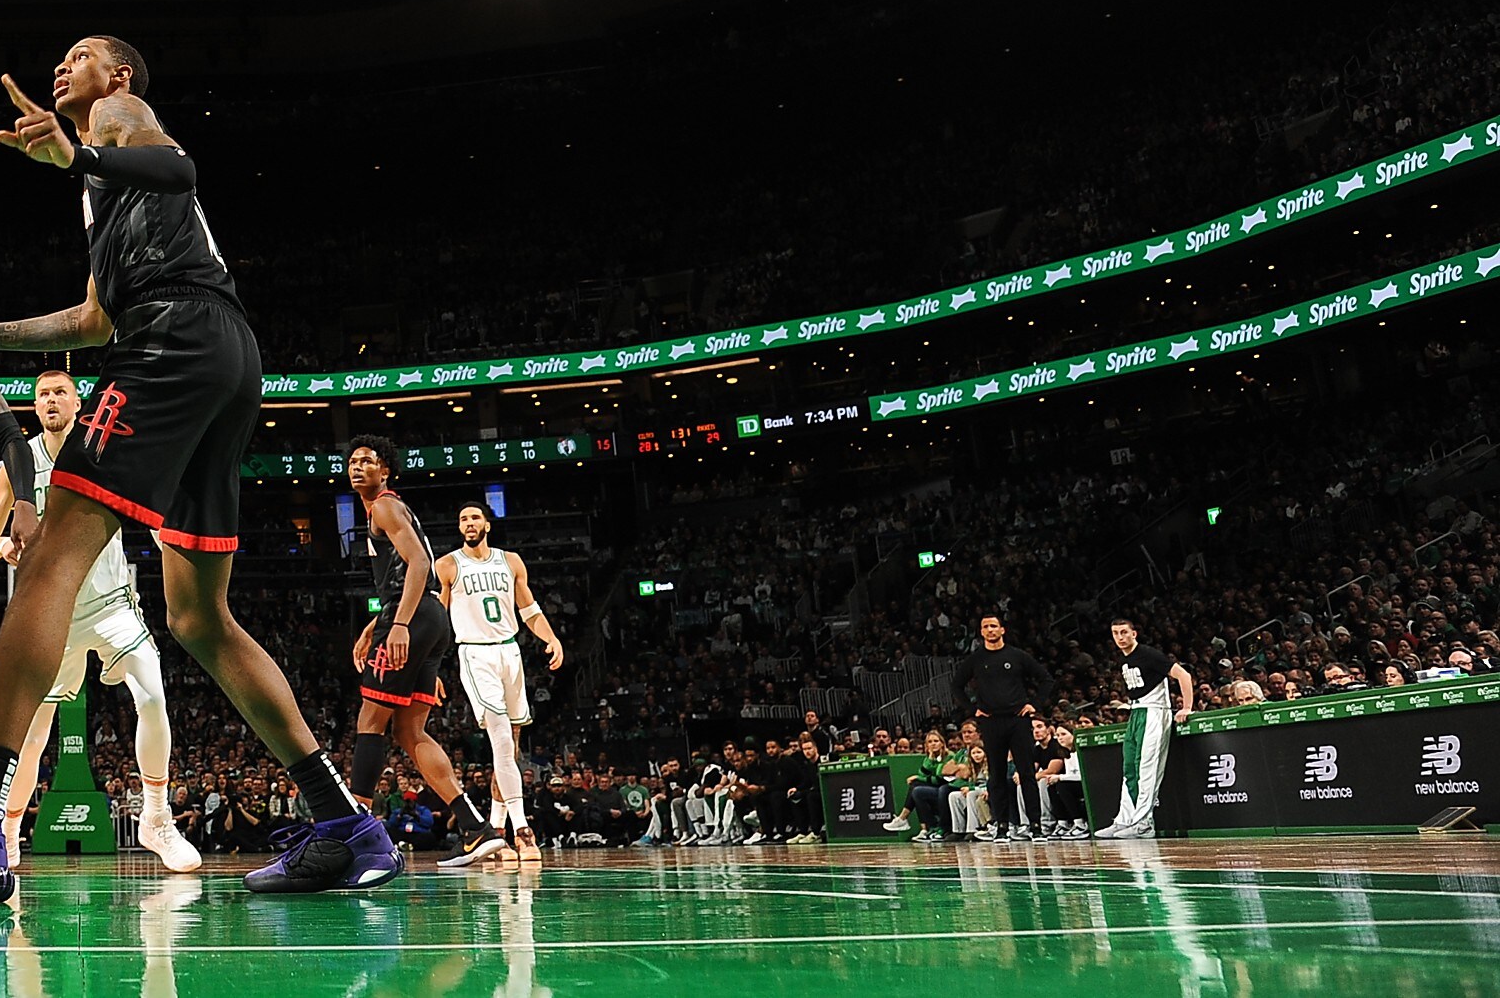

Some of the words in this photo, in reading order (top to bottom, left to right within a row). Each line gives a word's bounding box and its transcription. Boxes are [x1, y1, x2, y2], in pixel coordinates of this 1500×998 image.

[705, 333, 750, 354] Sprite
[798, 317, 846, 339] Sprite
[896, 299, 939, 323] Sprite
[986, 275, 1032, 301] Sprite
[1082, 251, 1132, 277] Sprite
[1186, 222, 1230, 252] Sprite
[1277, 189, 1324, 220] Sprite
[1376, 152, 1428, 185] Sprite
[917, 388, 963, 412] Sprite
[1009, 367, 1056, 393] Sprite
[1106, 347, 1157, 373] Sprite
[1211, 324, 1262, 351] Sprite
[1310, 295, 1358, 325] Sprite
[1410, 264, 1463, 296] Sprite
[261, 377, 299, 396] prite
[342, 373, 388, 392] Sprite
[431, 366, 477, 385] Sprite
[523, 358, 569, 377] Sprite
[615, 347, 660, 368] Sprite
[804, 410, 834, 424] 7:34
[836, 406, 859, 420] PM
[739, 419, 759, 433] TD
[763, 416, 794, 429] Bank
[596, 439, 611, 451] 15
[638, 441, 652, 452] 28
[706, 432, 720, 444] 29
[285, 464, 293, 475] 2
[307, 464, 316, 474] 6
[330, 463, 343, 473] 53
[406, 457, 425, 469] 3/8
[446, 455, 453, 466] 3
[472, 453, 480, 464] 3
[499, 451, 507, 462] 5
[522, 449, 536, 460] 10
[462, 572, 509, 596] CELTICS
[482, 597, 502, 623] 0
[63, 736, 84, 746] VISTA
[63, 745, 84, 754] PRINT
[1299, 788, 1317, 801] new
[1316, 786, 1353, 800] balance
[1414, 783, 1435, 795] new
[1435, 779, 1480, 794] balance
[1203, 793, 1218, 804] new
[1218, 791, 1249, 803] balance
[66, 824, 96, 832] balance
